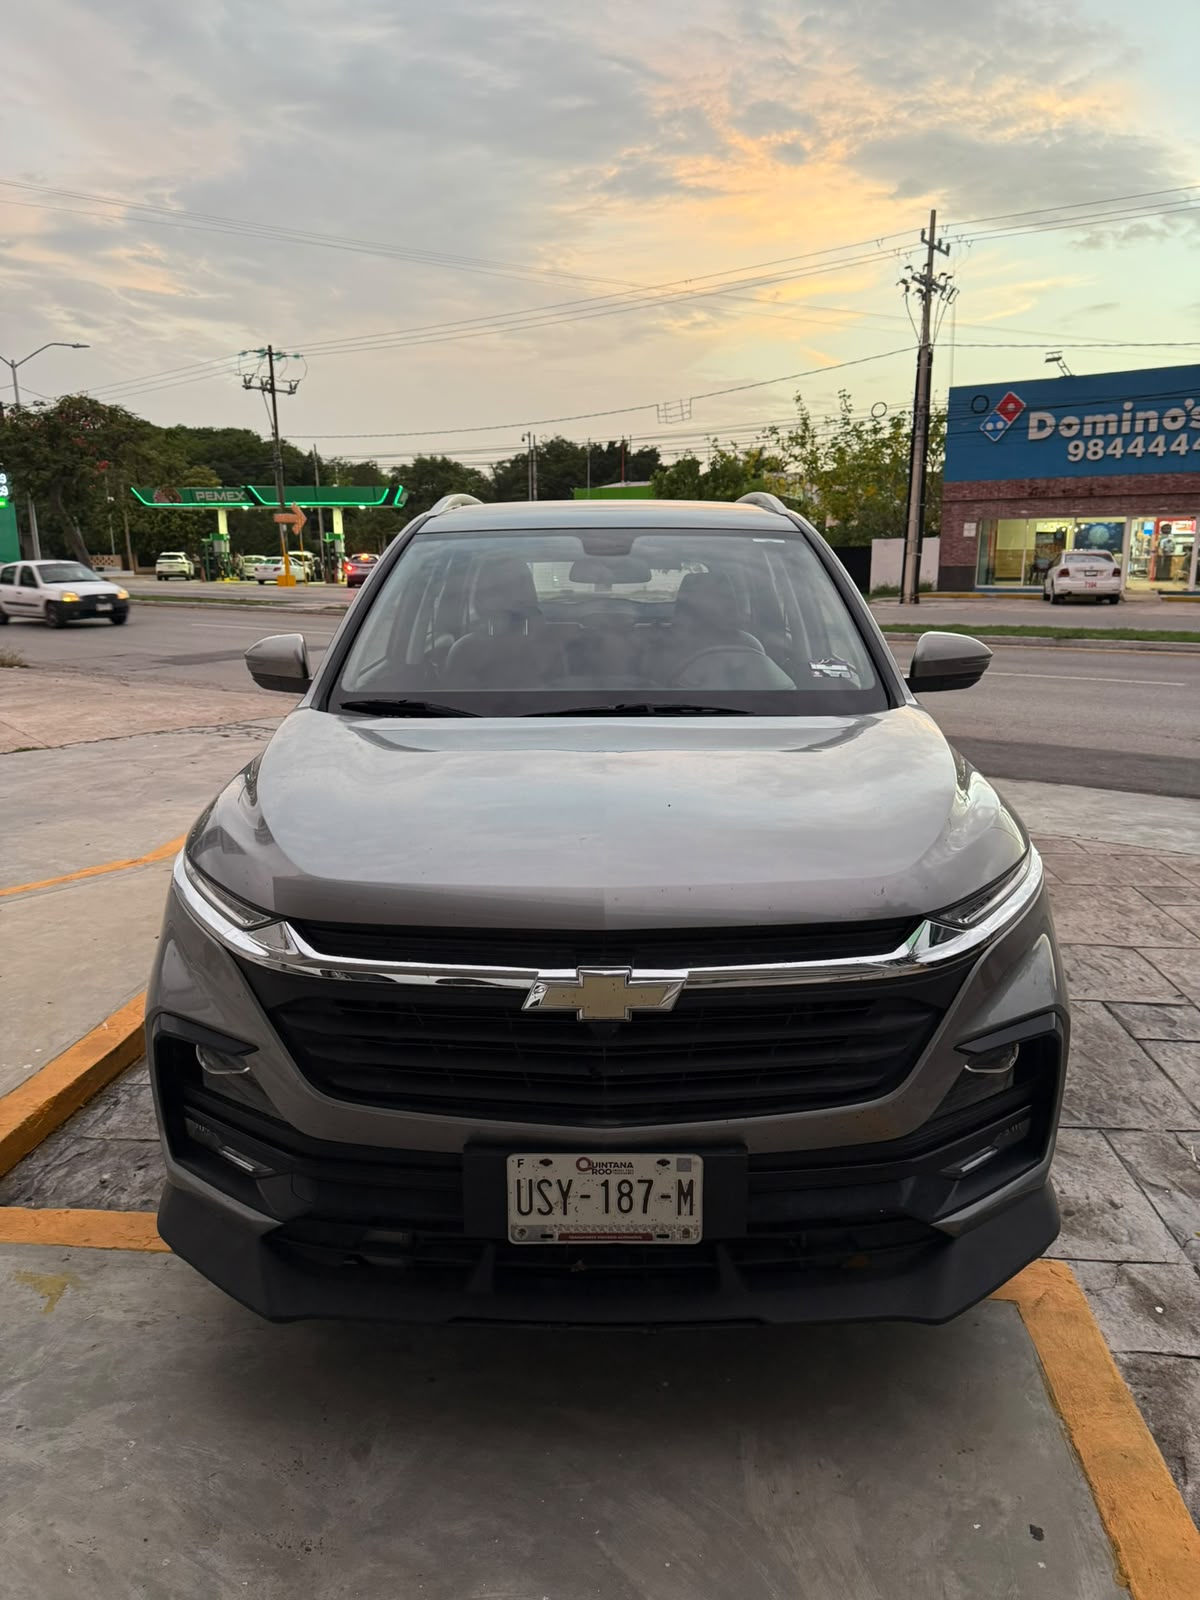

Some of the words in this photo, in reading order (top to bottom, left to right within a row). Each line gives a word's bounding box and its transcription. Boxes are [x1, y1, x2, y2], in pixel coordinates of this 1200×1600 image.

[195, 490, 246, 502] PEMEX
[517, 1158, 525, 1168] F
[575, 1156, 634, 1172] QUINTANA
[591, 1168, 612, 1176] ROO
[516, 1178, 694, 1216] USY-187-M
